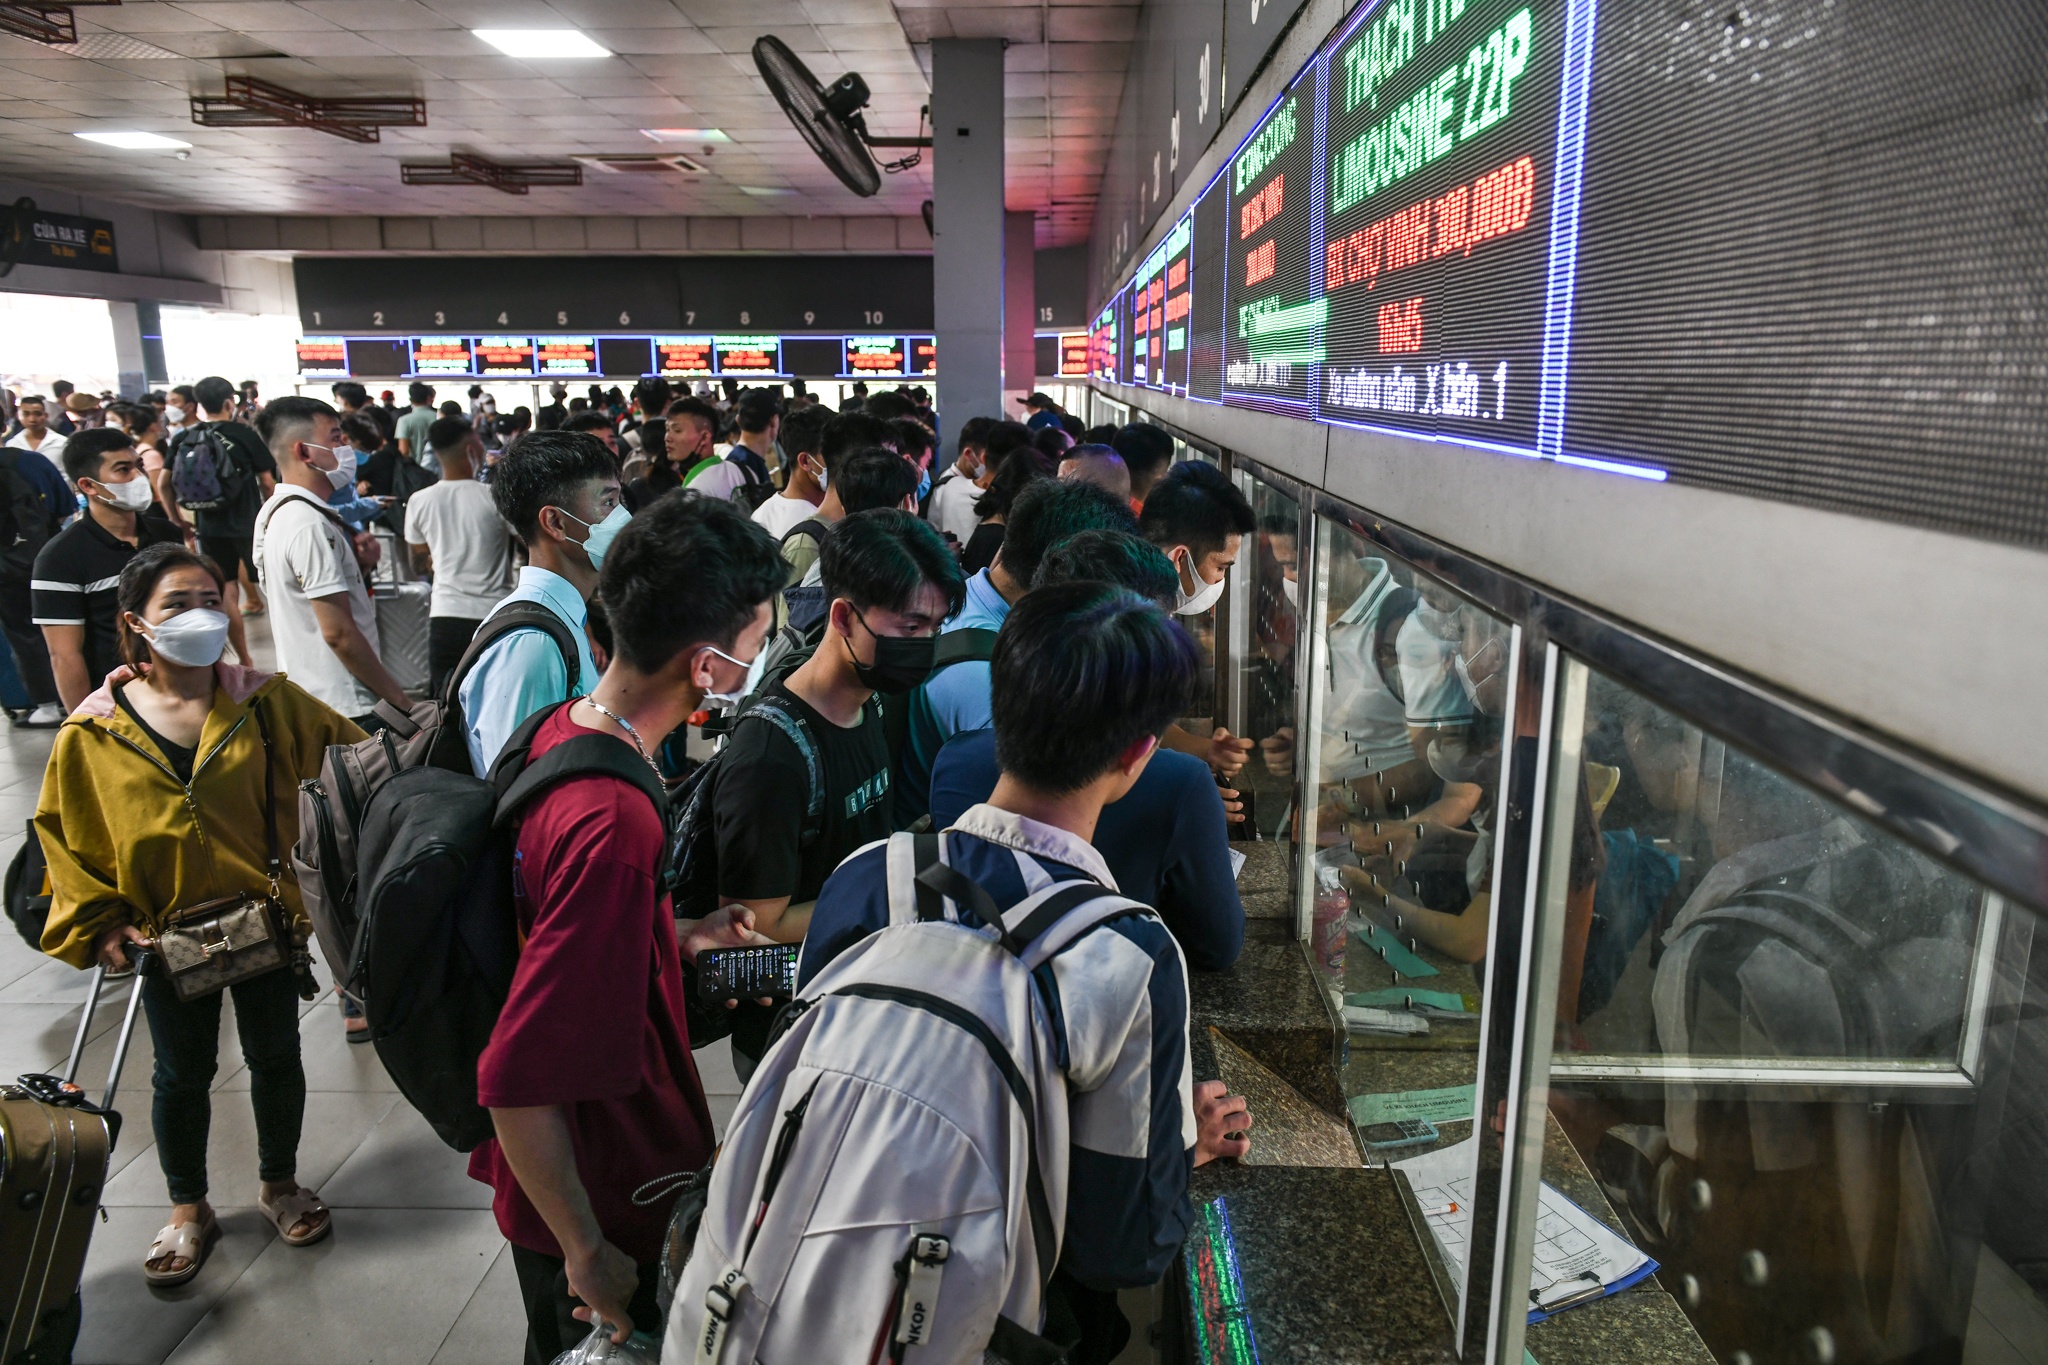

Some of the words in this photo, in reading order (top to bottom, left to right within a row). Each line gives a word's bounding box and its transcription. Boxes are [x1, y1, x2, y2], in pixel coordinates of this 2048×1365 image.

[1460, 8, 1533, 141] 22P
[58, 226, 72, 242] RA
[72, 229, 87, 244] XE
[314, 312, 321, 326] 1
[373, 312, 384, 326] 2
[435, 312, 445, 326] 3
[497, 312, 508, 326] 4
[558, 312, 568, 326] 5
[619, 312, 630, 326] 6
[686, 311, 696, 326] 7
[740, 311, 750, 326] 8
[804, 311, 815, 325] 9
[864, 311, 883, 326] 10
[1040, 307, 1053, 322] 15
[907, 1302, 927, 1345] NKOP
